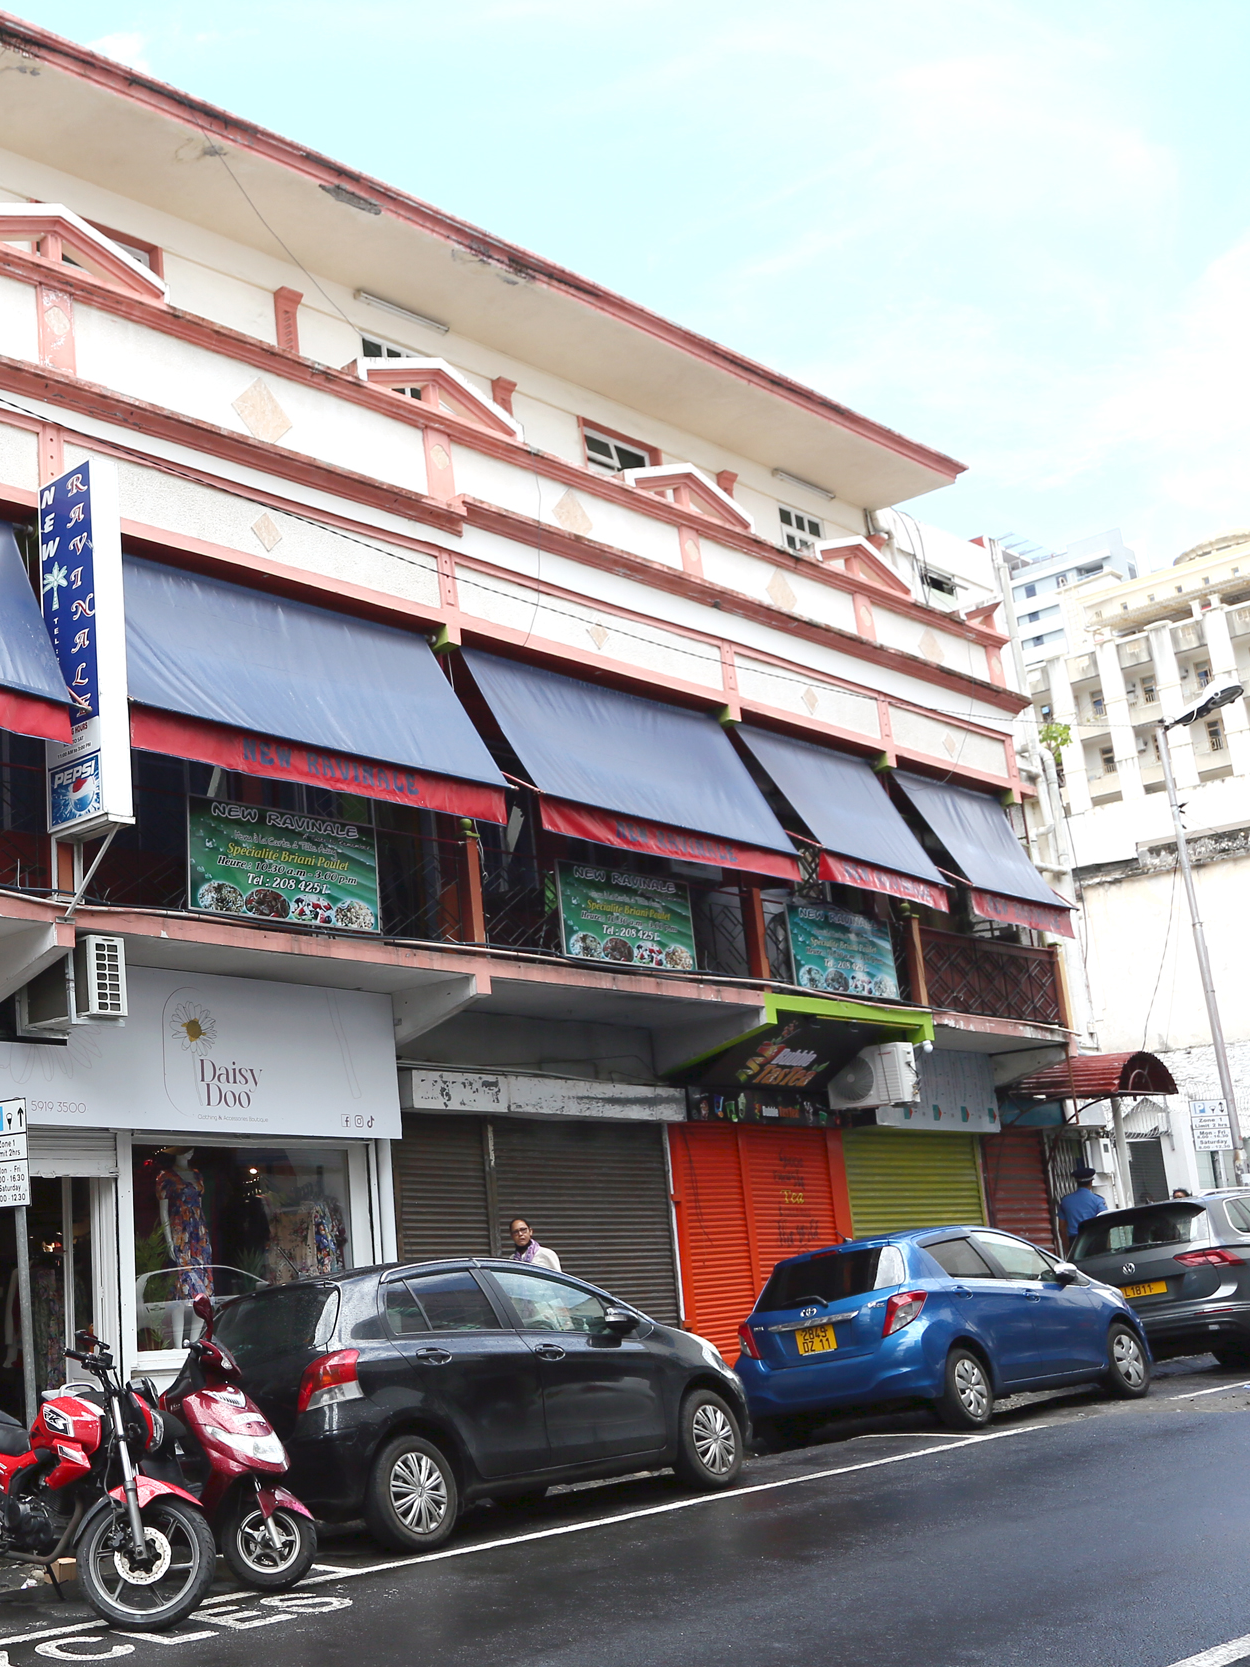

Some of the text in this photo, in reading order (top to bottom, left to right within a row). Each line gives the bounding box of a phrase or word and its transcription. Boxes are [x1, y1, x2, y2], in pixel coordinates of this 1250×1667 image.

[41, 485, 59, 561] NEW
[54, 758, 96, 788] PEPSI
[243, 736, 420, 796] NEW RAVINALE
[211, 802, 358, 838] NEW RAVINALE
[616, 820, 738, 863] NEW RAVINALE
[227, 842, 349, 871] Specialité Briani Poulet
[255, 862, 285, 874] 10.30
[247, 873, 326, 894] Tel 208 4251
[573, 866, 676, 894] NEW RAVINALE
[620, 927, 637, 938] 208
[199, 1058, 262, 1093] Daisy
[31, 1101, 87, 1114] 5919 3500
[206, 1083, 251, 1109] Doo
[780, 1189, 804, 1204] Tea
[802, 1328, 828, 1341] 2849
[803, 1338, 831, 1353] DZ 11
